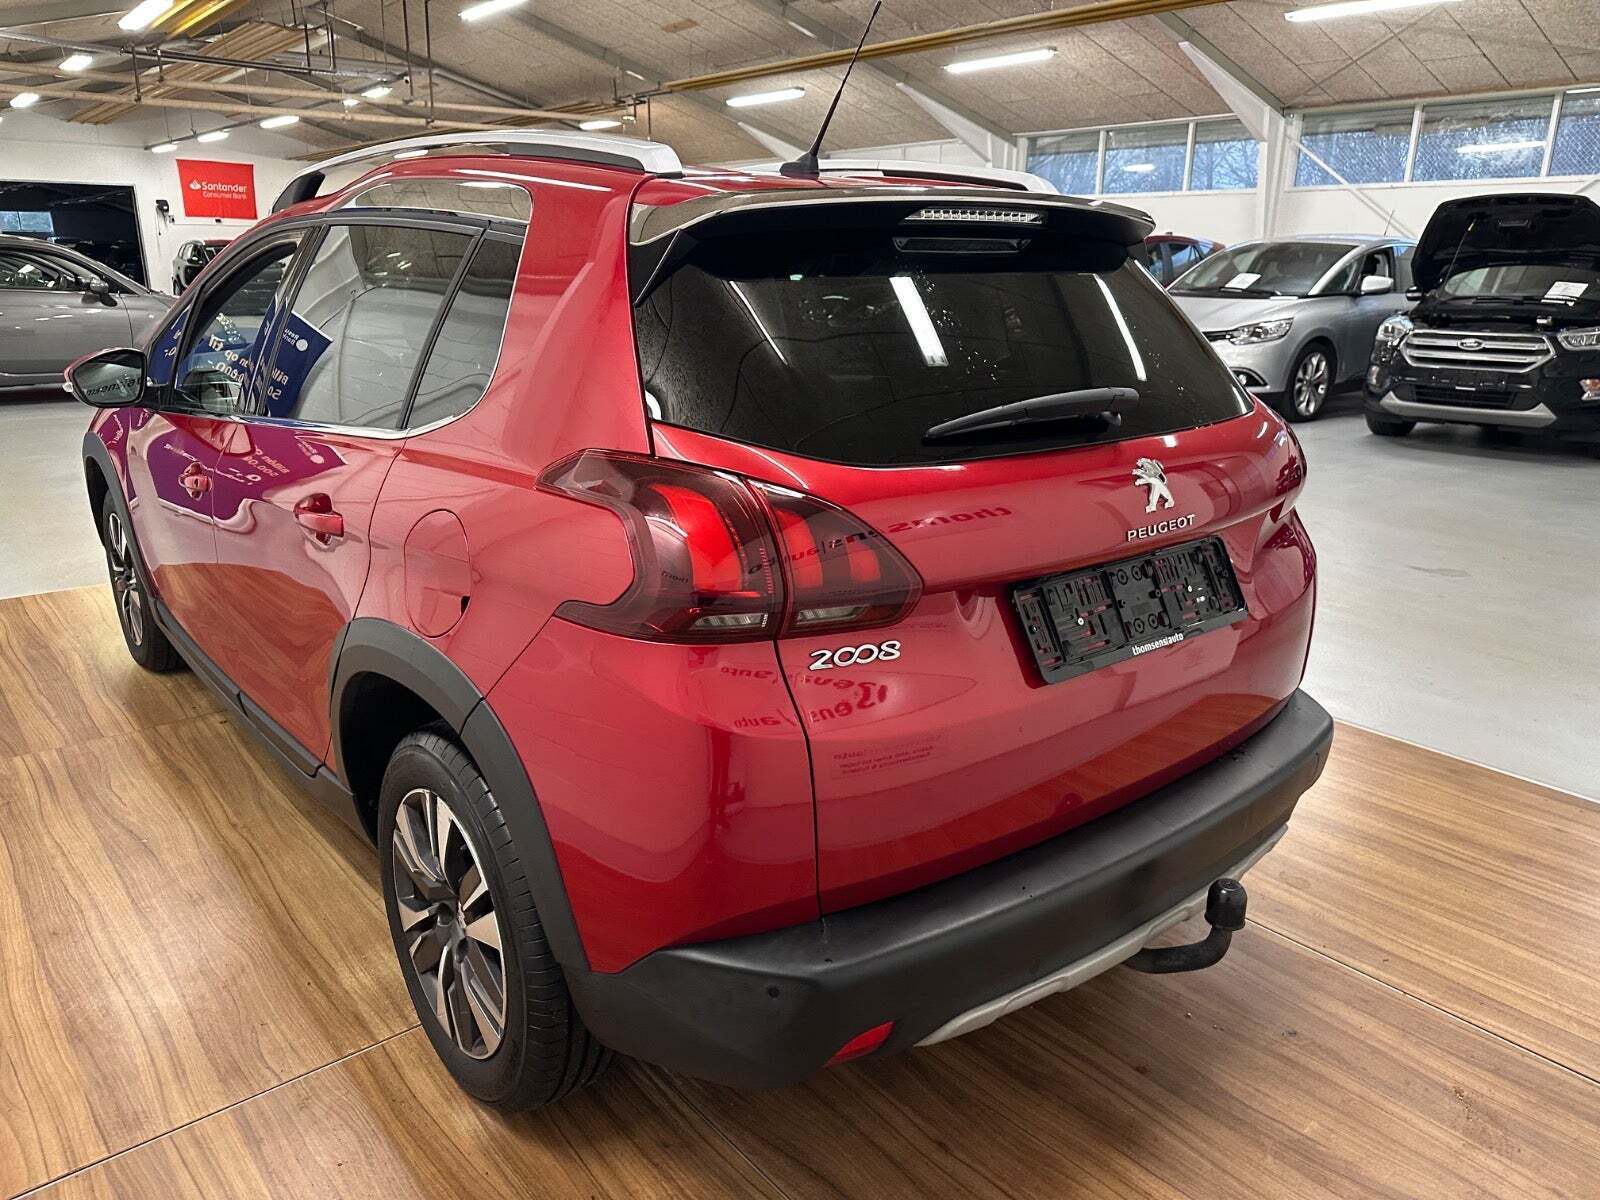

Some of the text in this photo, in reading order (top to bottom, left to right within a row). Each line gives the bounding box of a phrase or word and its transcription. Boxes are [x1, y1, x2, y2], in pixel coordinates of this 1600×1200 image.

[201, 181, 247, 193] Santander
[1126, 513, 1196, 542] PEUGEOT
[809, 639, 902, 672] 2008
